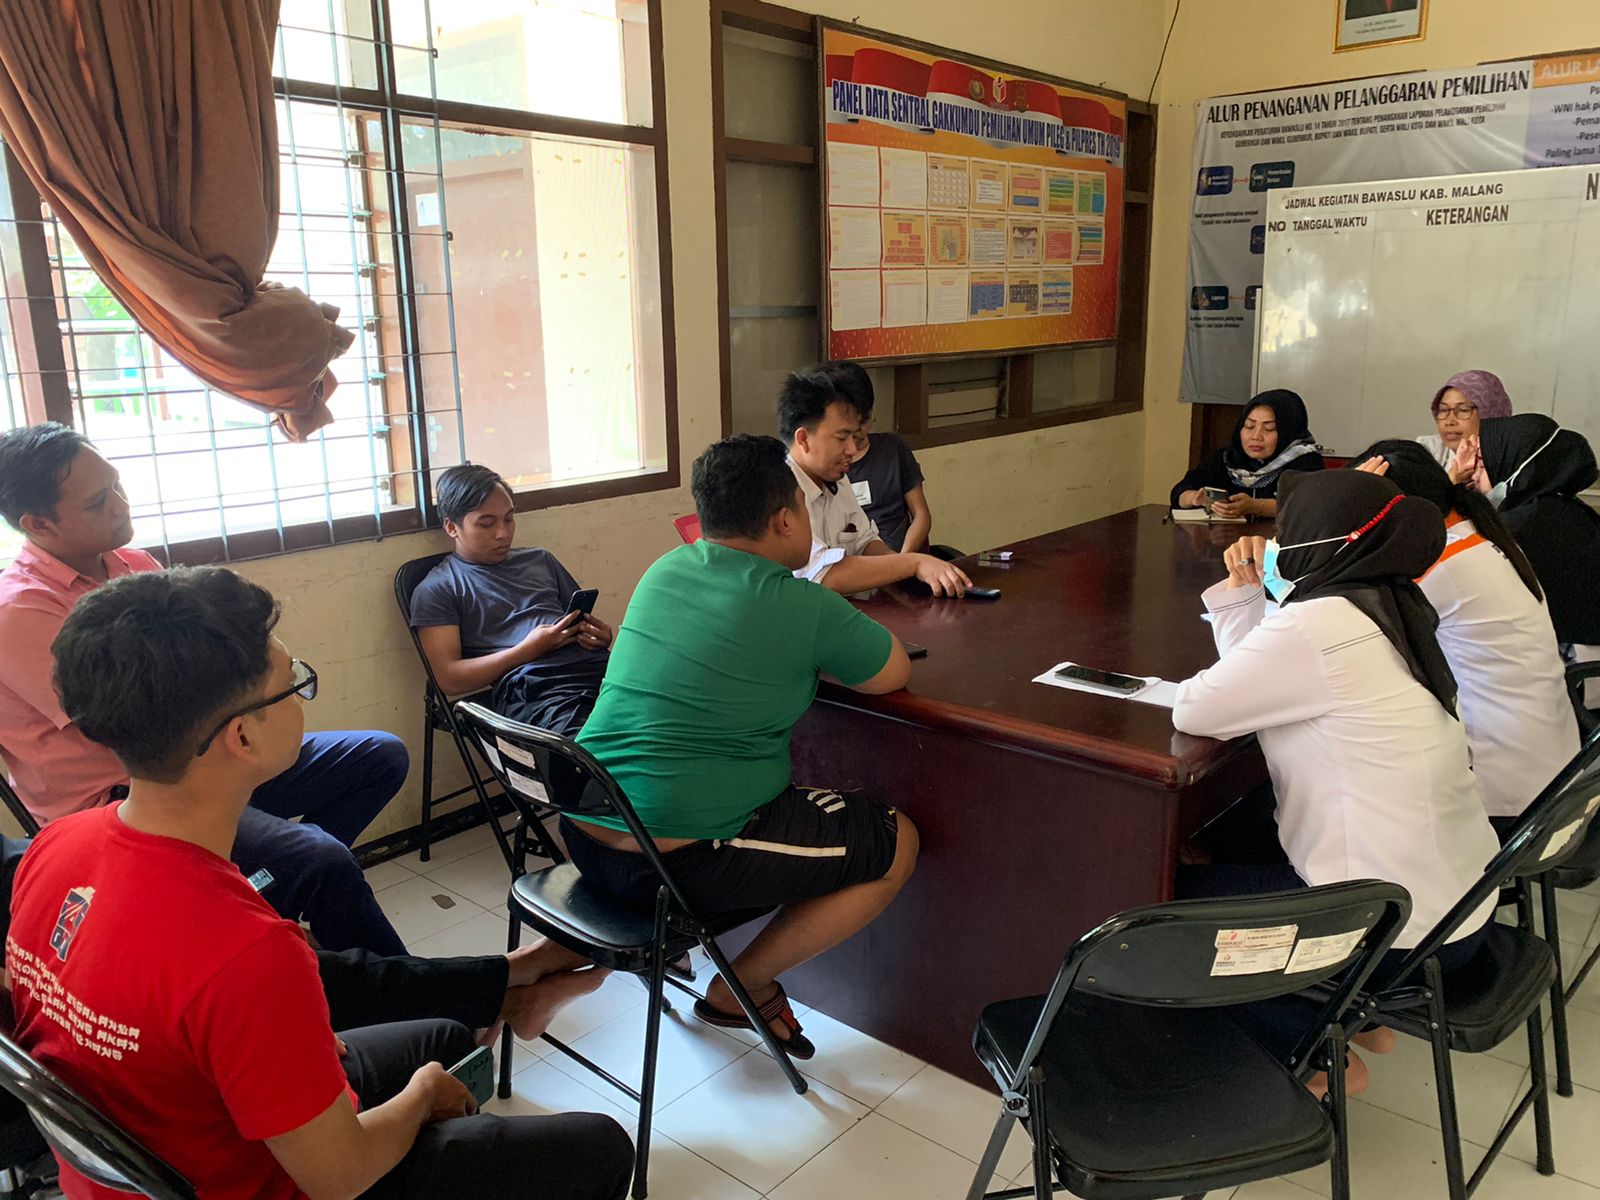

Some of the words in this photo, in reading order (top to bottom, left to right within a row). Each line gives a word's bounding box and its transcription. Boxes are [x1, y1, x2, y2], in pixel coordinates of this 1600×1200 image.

[1541, 61, 1581, 79] ALUR
[1206, 103, 1240, 123] ALUR
[1243, 93, 1330, 121] PENANGANAN
[1334, 80, 1438, 110] PELANGGARAN
[1441, 70, 1530, 99] PEMILIHAN
[1574, 101, 1591, 111] hak
[832, 80, 864, 116] PANEL
[865, 86, 890, 120] DATA
[891, 91, 931, 127] SENTRAL
[932, 100, 980, 137] GAKKUMDU
[981, 109, 1022, 143] PEMILIHAN
[1022, 118, 1046, 147] UMUM
[1046, 122, 1065, 150] PILEG
[1106, 133, 1121, 158] 2019
[1545, 148, 1572, 159] Paling
[1573, 147, 1595, 156] lama
[1285, 197, 1317, 210] JADWAL
[1318, 193, 1359, 206] KEGIATAN
[1361, 189, 1416, 204] BAWASLU
[1419, 187, 1448, 200] KAB.
[1451, 183, 1503, 198] MALANG
[1426, 205, 1509, 226] KETERANGAN
[1268, 221, 1286, 232] NO
